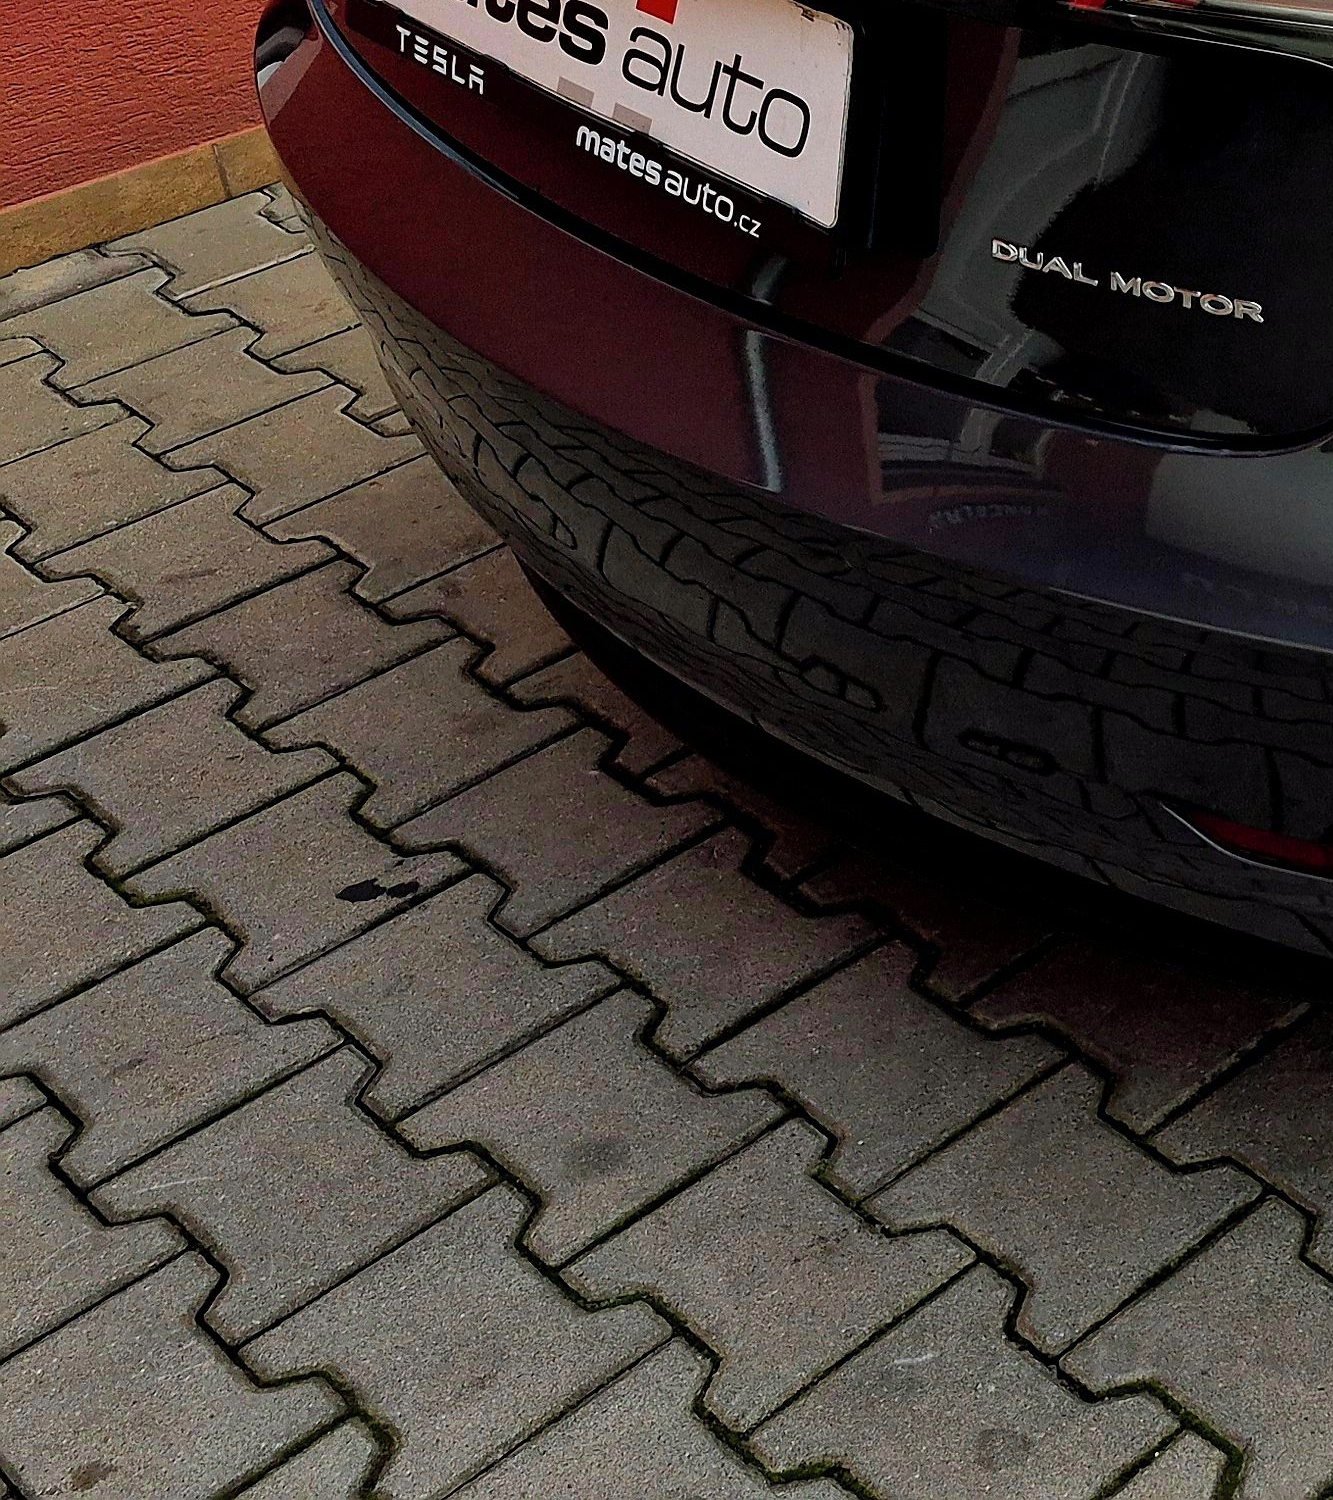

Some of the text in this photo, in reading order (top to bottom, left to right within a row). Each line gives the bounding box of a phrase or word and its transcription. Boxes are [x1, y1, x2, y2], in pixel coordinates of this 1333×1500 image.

[396, 25, 486, 95] TESLA
[621, 25, 811, 159] auto
[575, 124, 763, 239] matesauto.cz
[991, 237, 1265, 324] DUAL MOTOR
